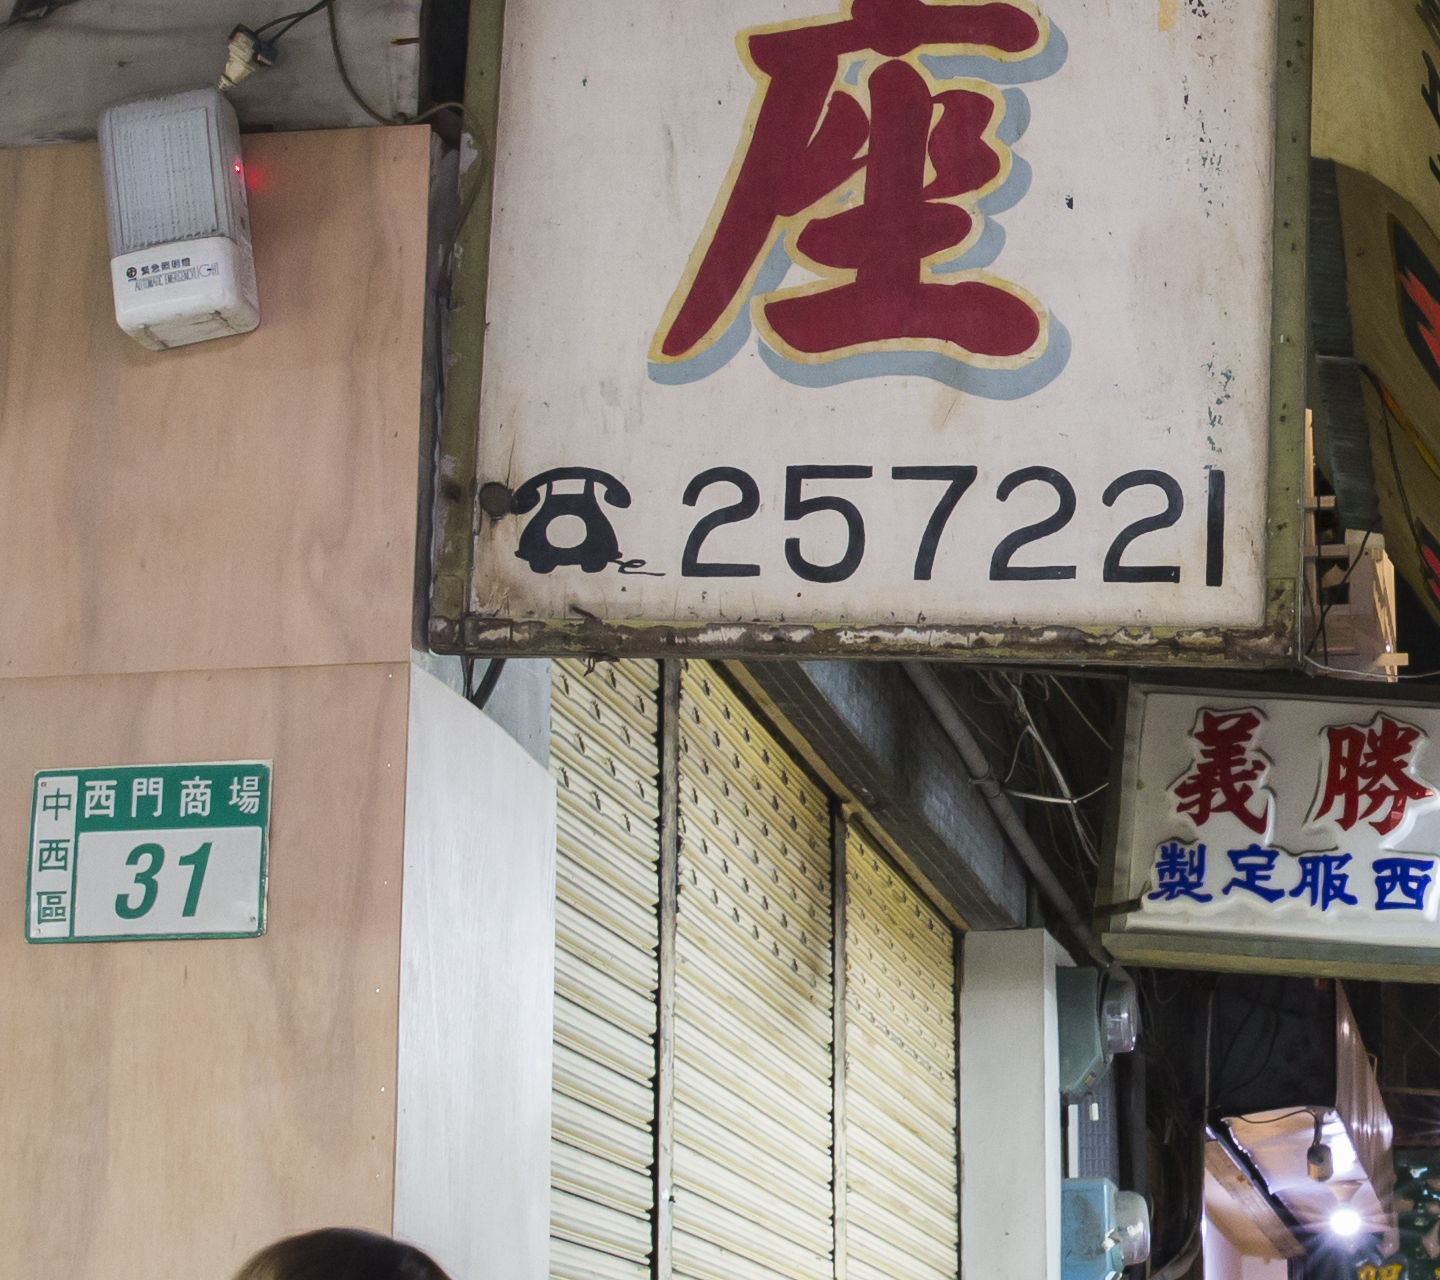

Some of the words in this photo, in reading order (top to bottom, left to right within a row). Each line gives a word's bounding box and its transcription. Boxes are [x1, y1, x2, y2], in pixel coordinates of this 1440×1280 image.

[680, 463, 1226, 587] 257221
[83, 775, 261, 819] 西門商場
[36, 787, 72, 925] 中西區
[114, 841, 213, 920] 31
